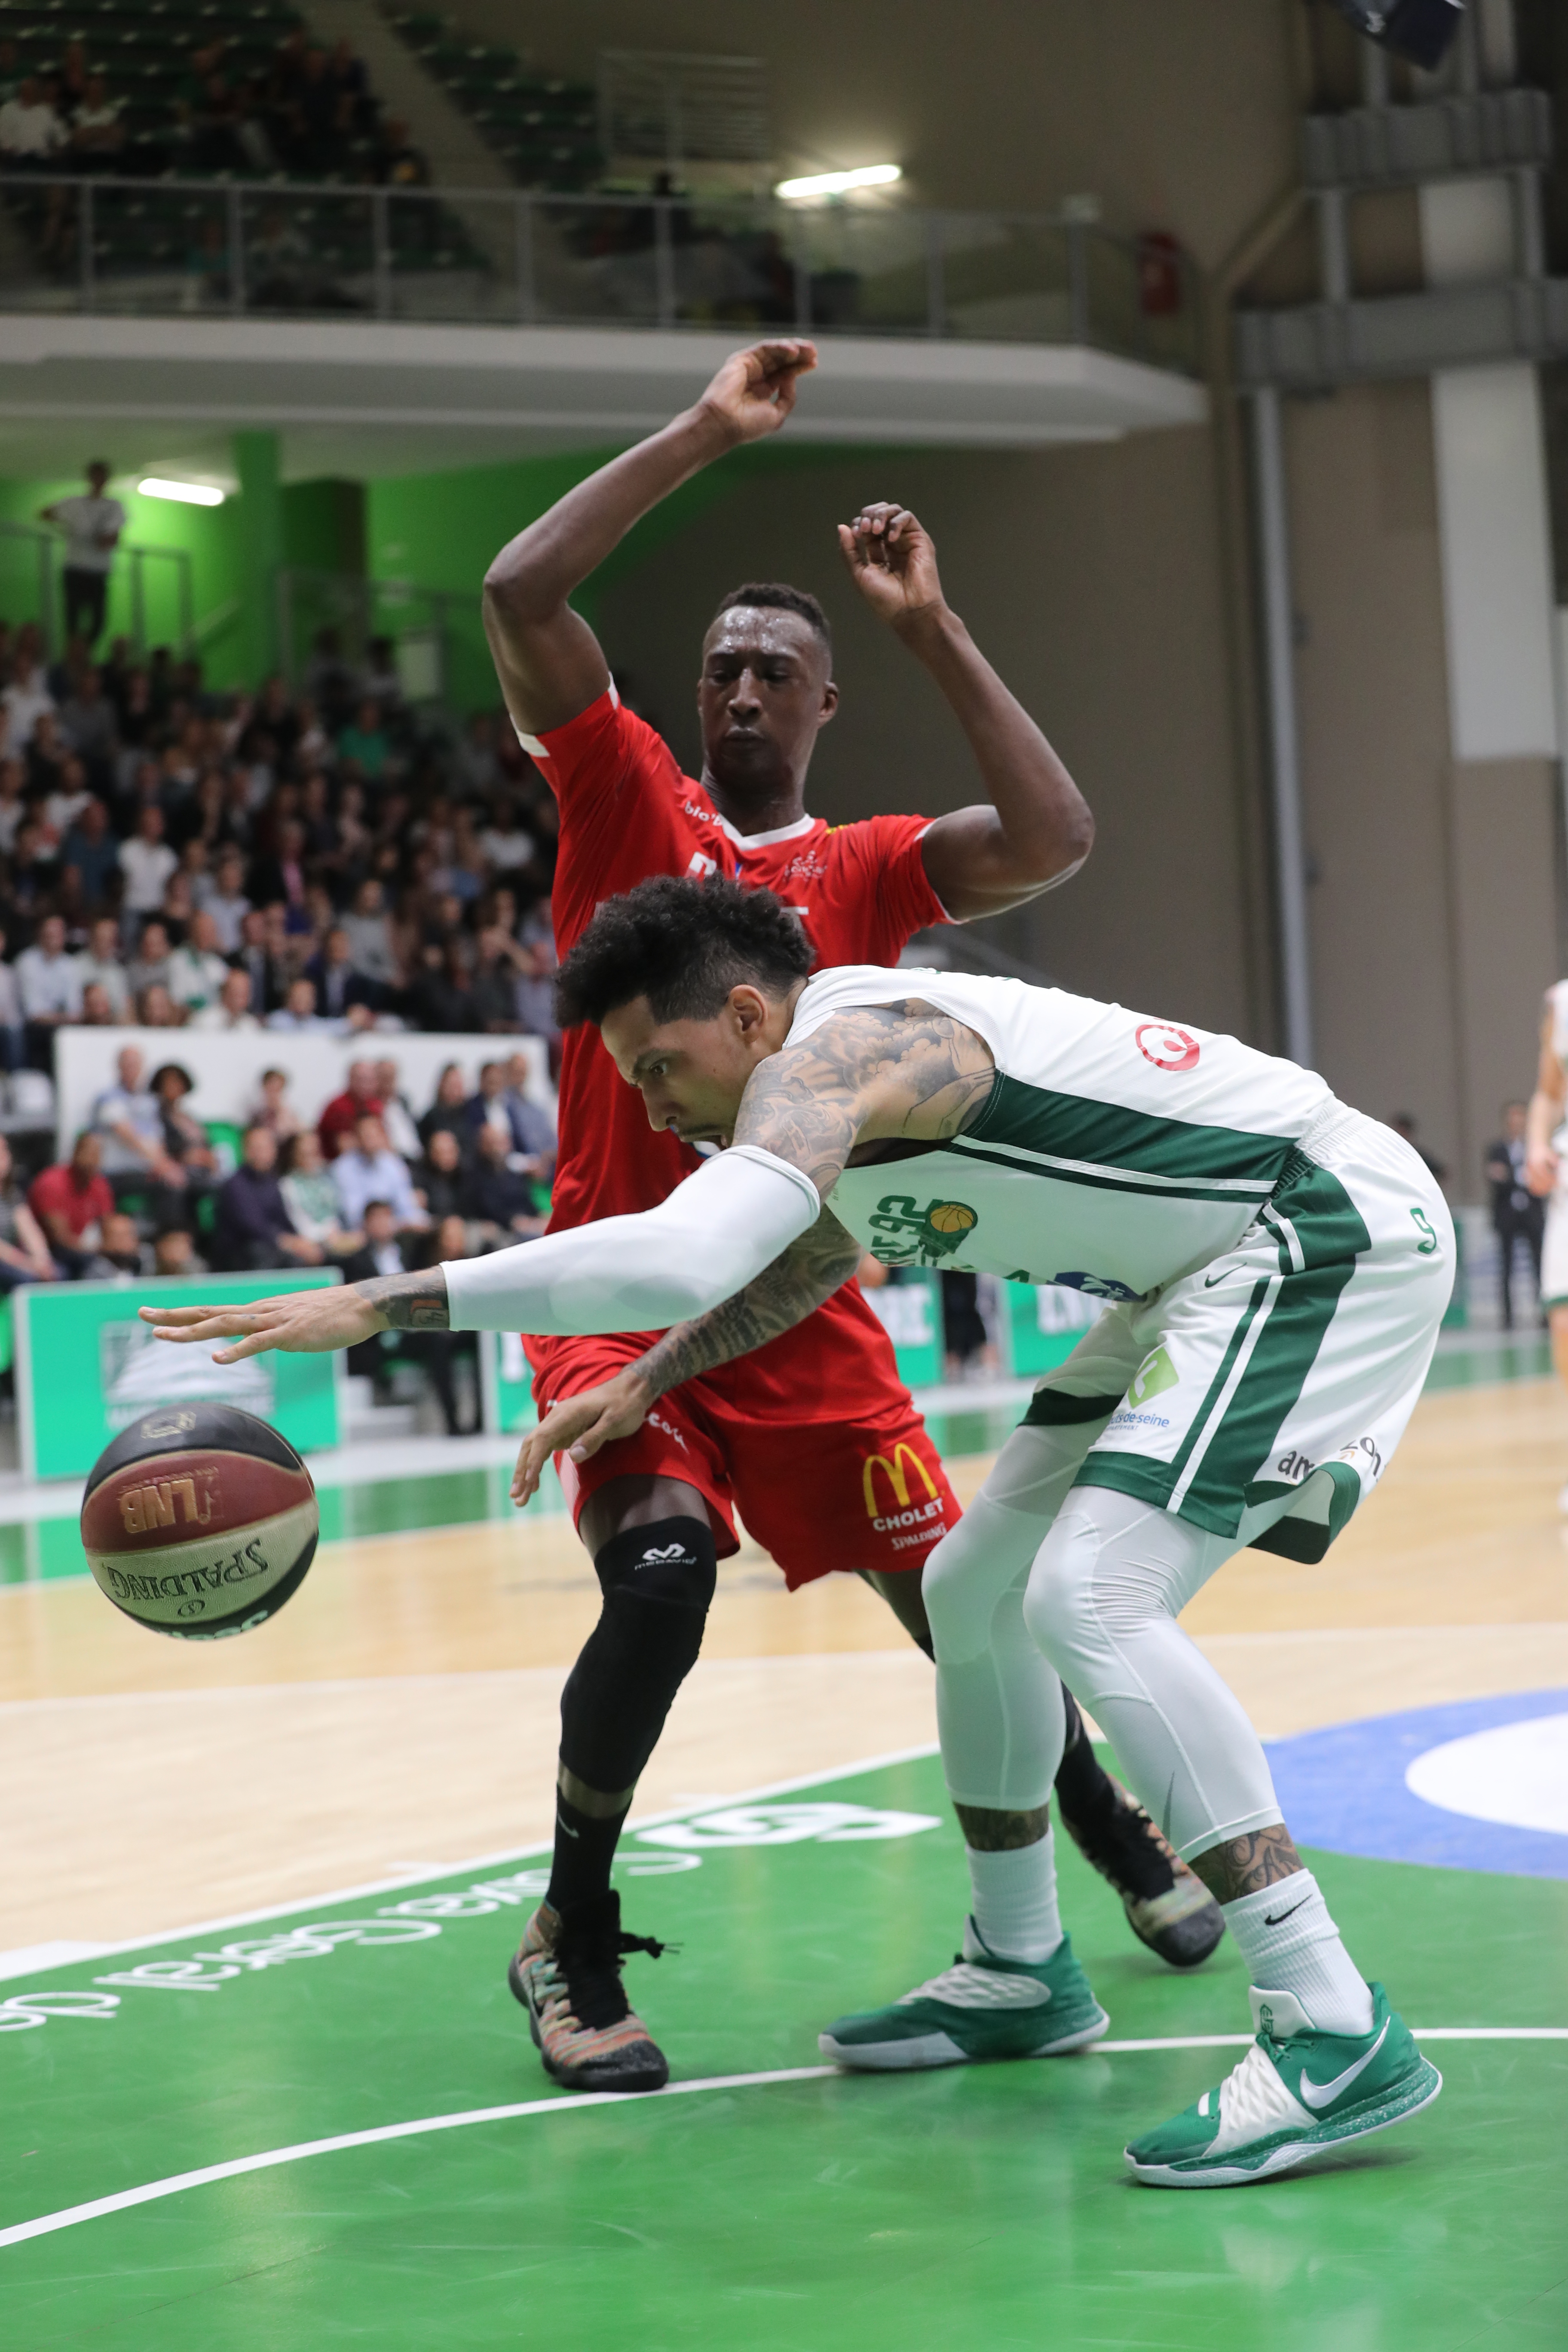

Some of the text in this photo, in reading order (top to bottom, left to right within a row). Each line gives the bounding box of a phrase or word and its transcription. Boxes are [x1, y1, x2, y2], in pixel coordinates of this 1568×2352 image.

[1410, 1207, 1436, 1255] 9
[1110, 1412, 1170, 1427] uts-de-seine
[119, 1478, 199, 1534] LNB
[873, 1497, 944, 1532] CHOLET
[107, 1537, 269, 1601] SPALDING
